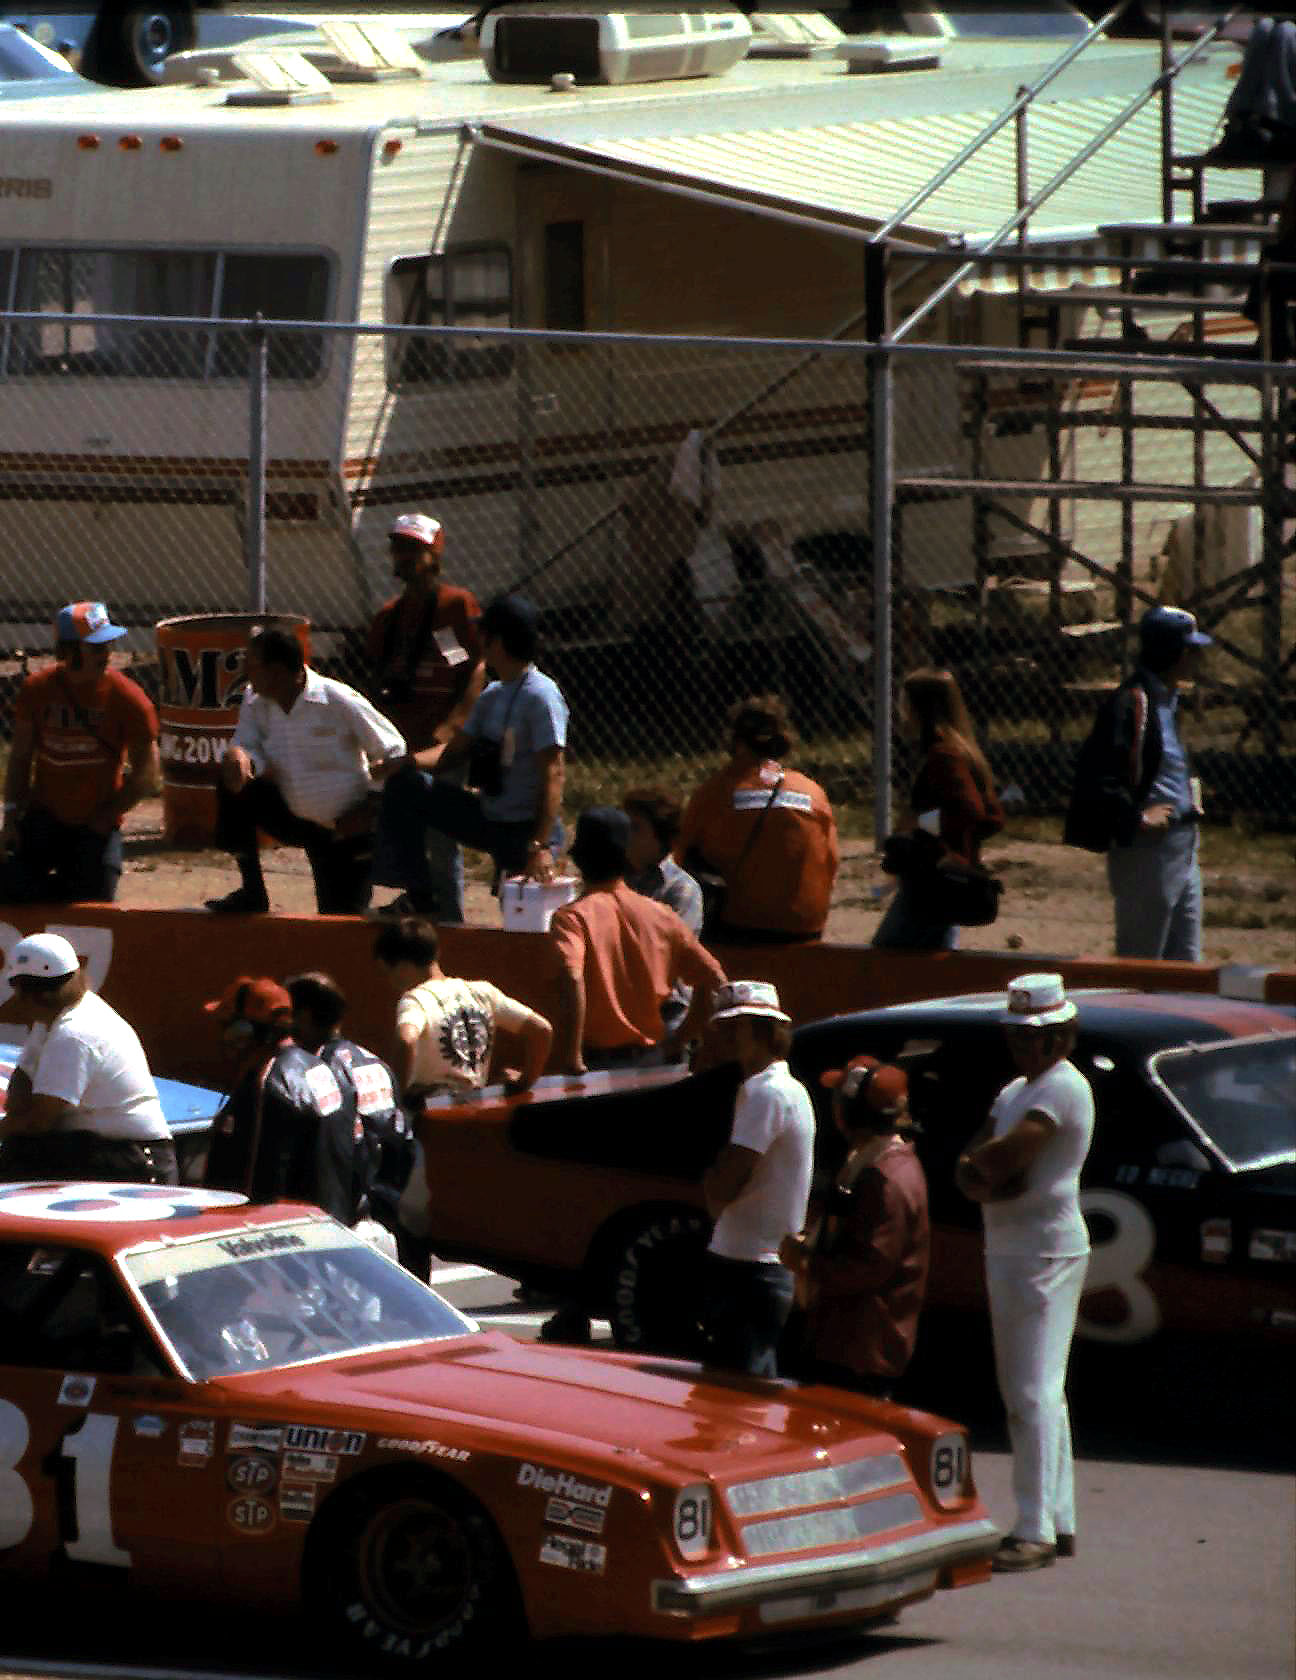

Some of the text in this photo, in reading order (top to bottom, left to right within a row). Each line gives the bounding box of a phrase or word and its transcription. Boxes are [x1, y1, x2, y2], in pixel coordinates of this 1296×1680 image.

[235, 1460, 270, 1487] STP
[516, 1461, 615, 1507] DieHard
[935, 1447, 964, 1489] 81
[234, 1500, 268, 1526] STP
[678, 1497, 711, 1541] 81
